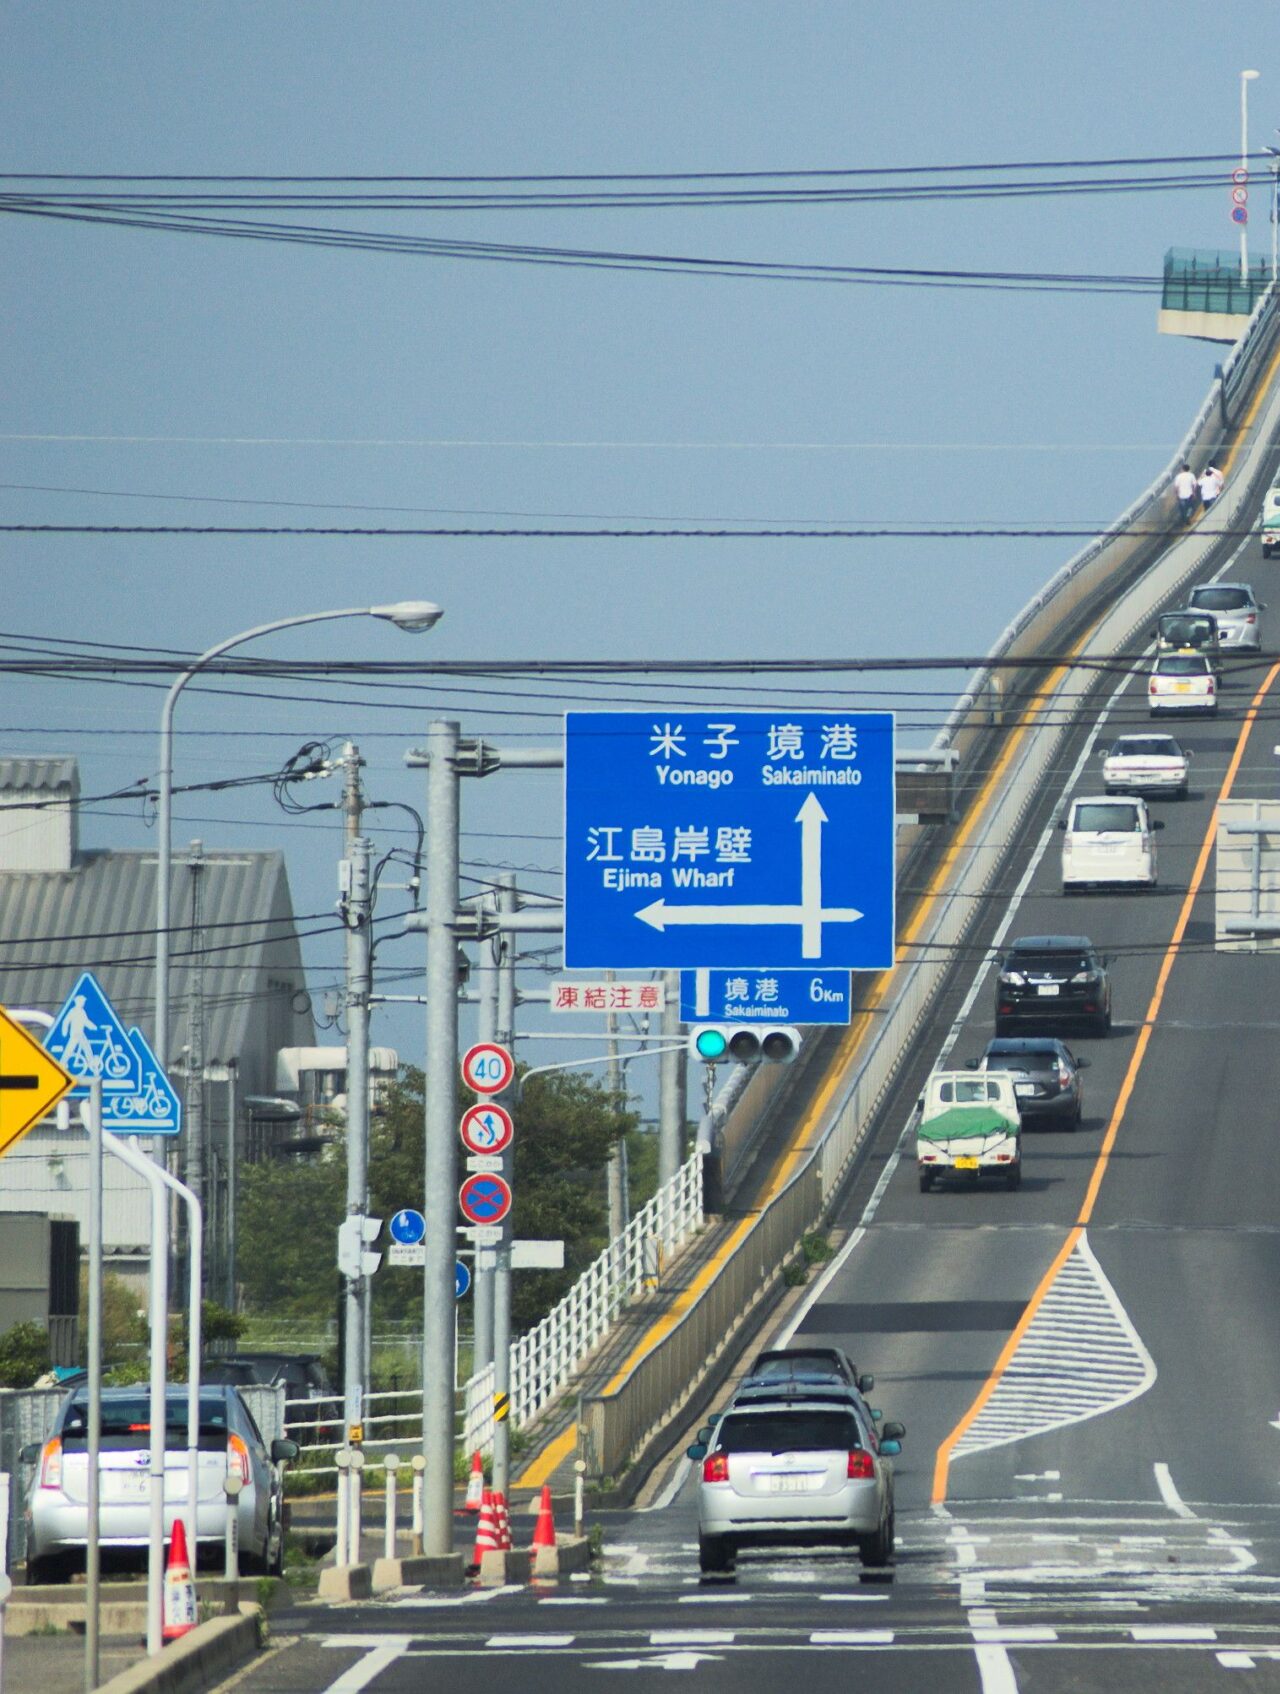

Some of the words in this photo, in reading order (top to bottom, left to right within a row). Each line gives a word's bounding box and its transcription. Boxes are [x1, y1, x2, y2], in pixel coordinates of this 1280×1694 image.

[649, 723, 740, 760] 米子
[766, 723, 858, 761] 境港
[656, 765, 734, 789] Yonago
[762, 765, 863, 786] Sakaiminato
[585, 825, 752, 863] 江島岸壁
[603, 869, 663, 892] Ejima
[671, 868, 735, 888] Wharf
[556, 986, 659, 1009] 凍結注意
[724, 977, 780, 1002] 境港
[724, 1004, 789, 1018] Sakaiminato
[475, 1058, 502, 1080] 40
